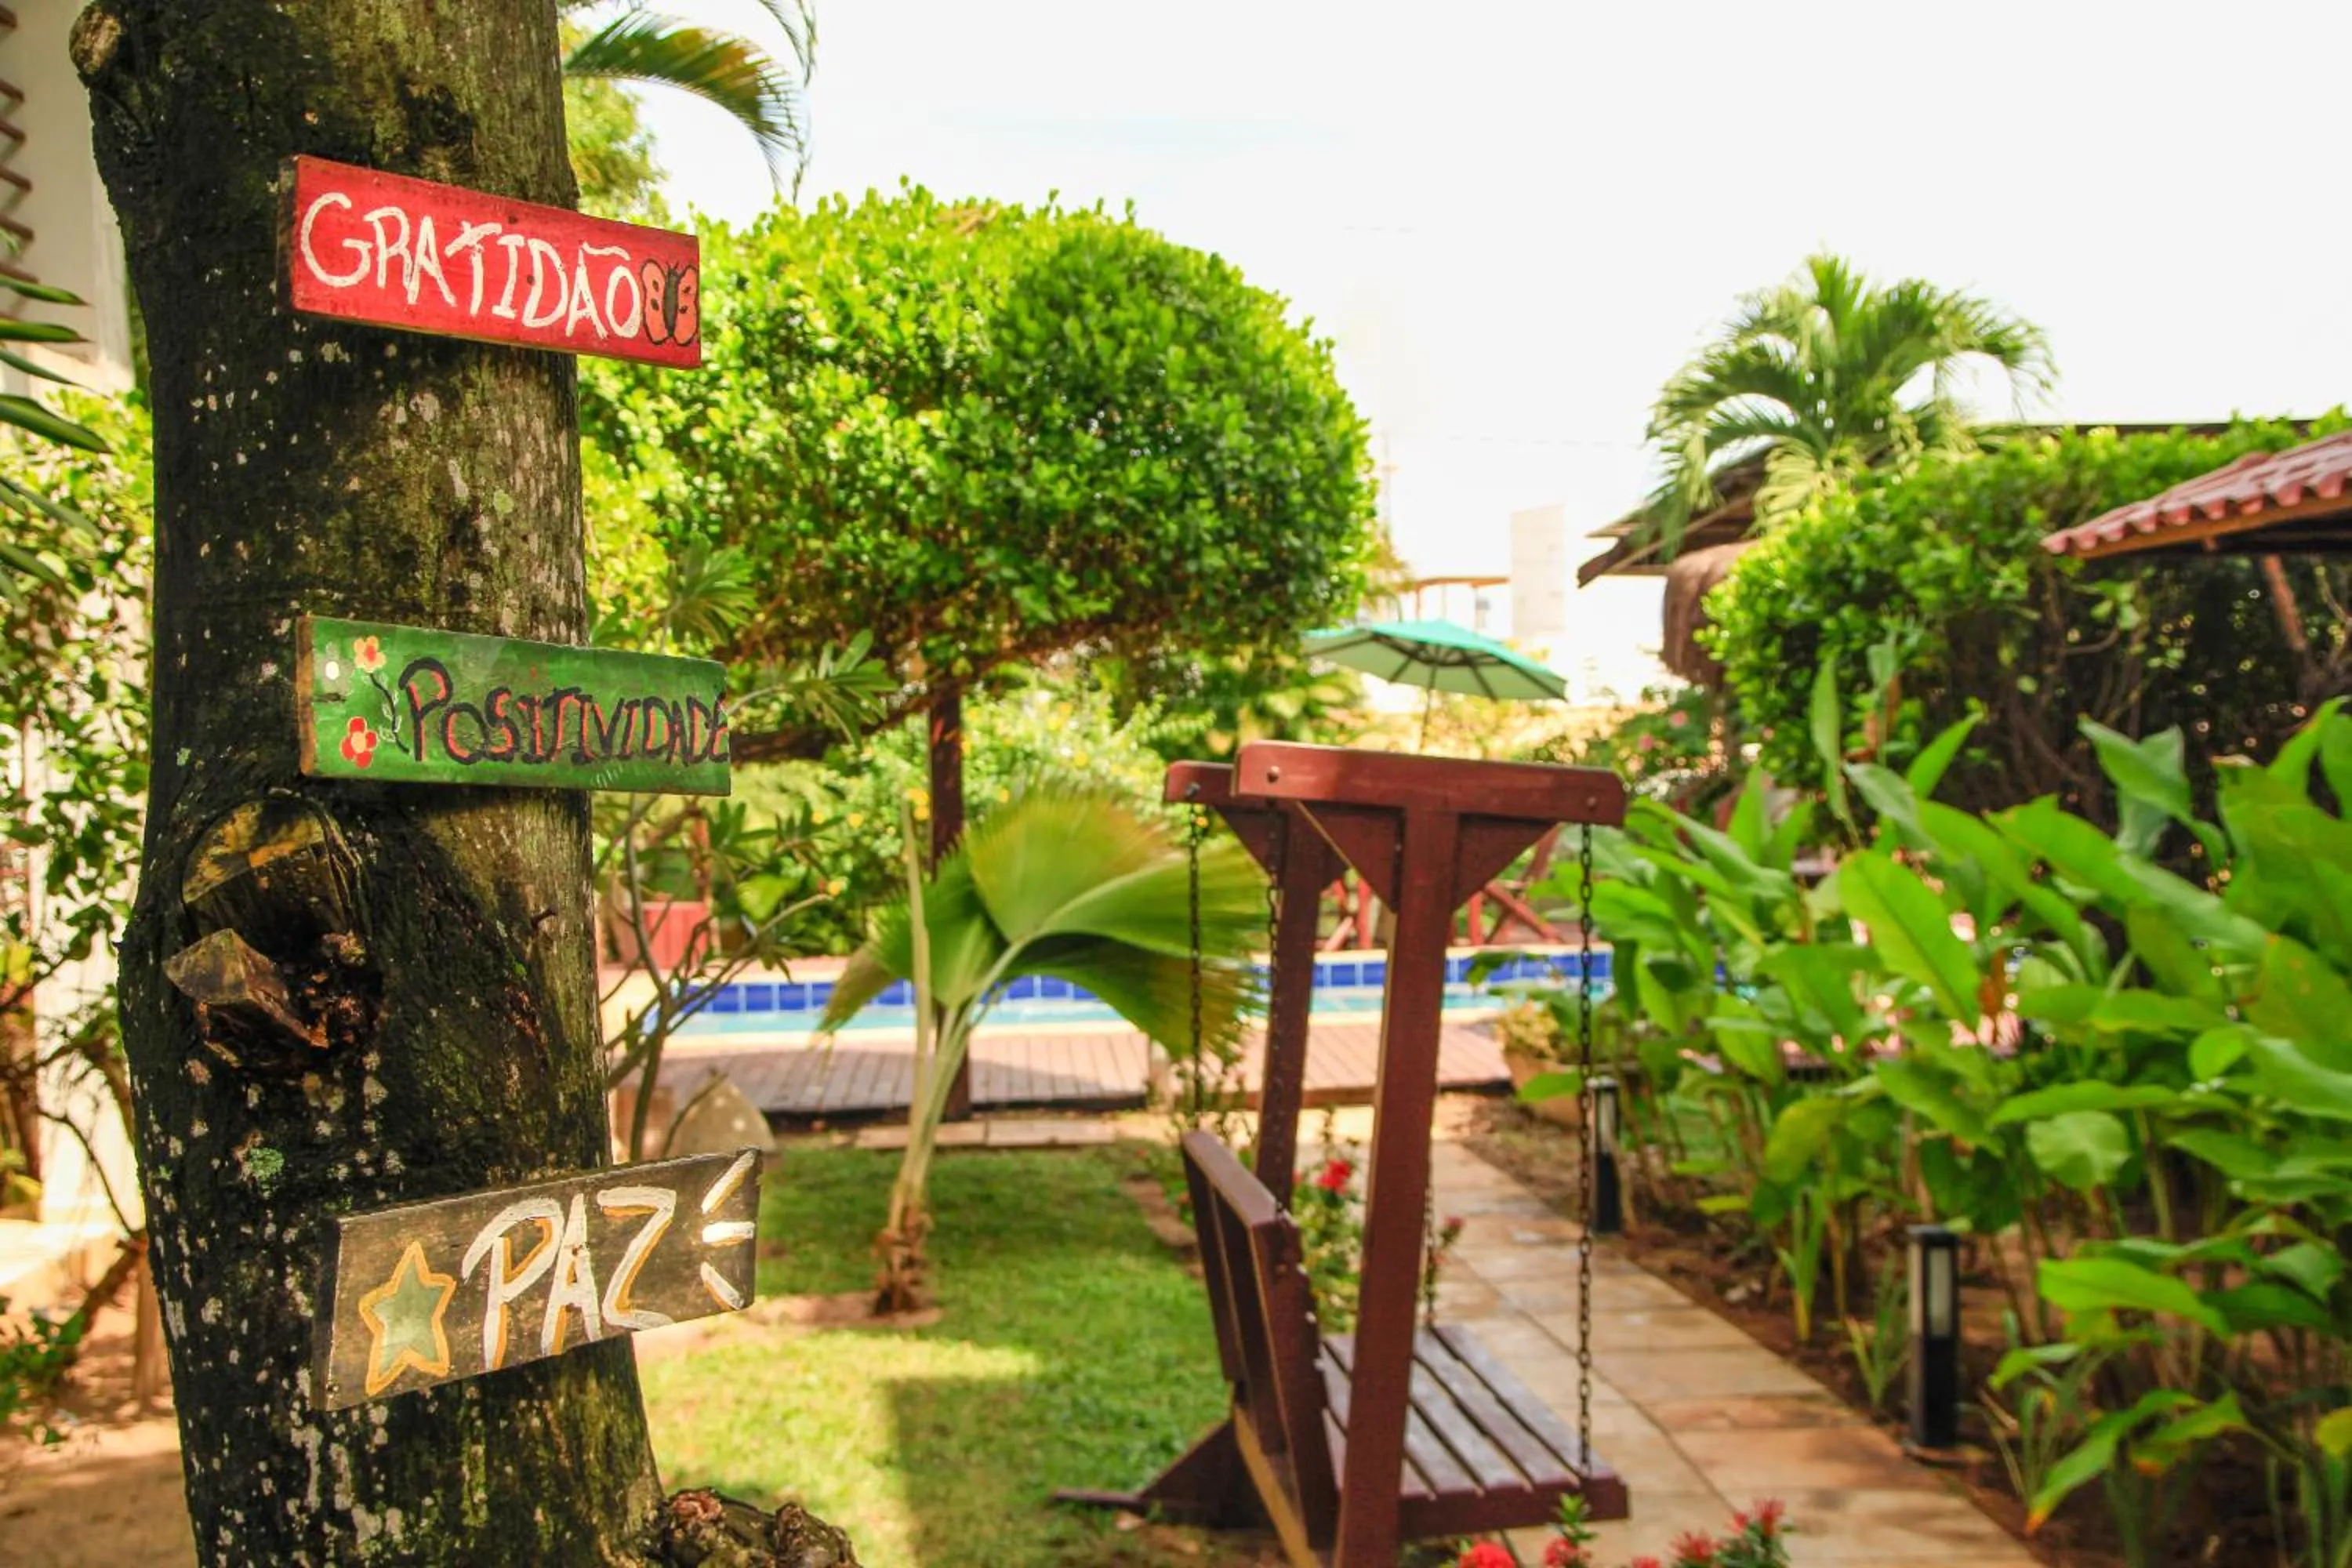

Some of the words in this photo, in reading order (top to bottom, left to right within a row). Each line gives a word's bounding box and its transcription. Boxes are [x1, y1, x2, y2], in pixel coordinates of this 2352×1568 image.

[300, 192, 641, 339] GRATIDÃO
[398, 657, 728, 766] POSITIVIDADE
[461, 1185, 677, 1370] PAZ
